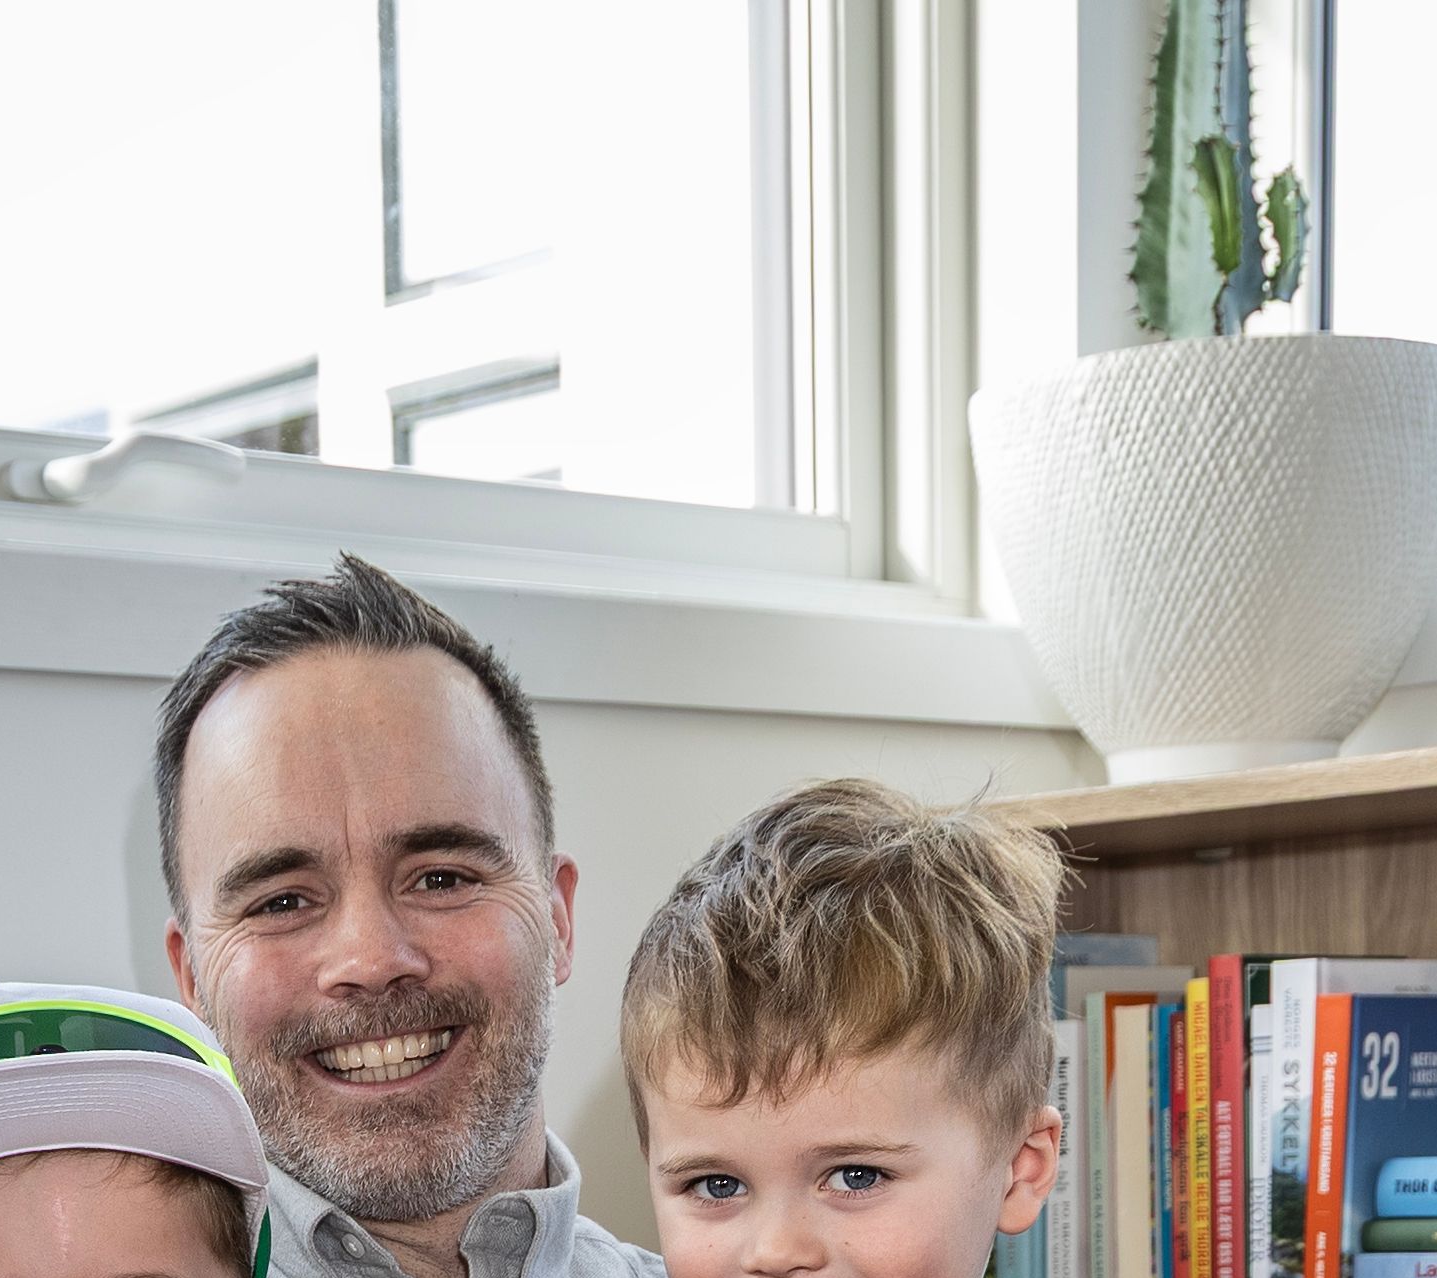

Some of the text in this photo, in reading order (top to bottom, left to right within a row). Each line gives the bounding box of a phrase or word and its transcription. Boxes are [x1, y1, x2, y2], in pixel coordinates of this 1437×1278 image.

[1193, 1001, 1208, 1050] MICAEL
[1193, 1051, 1209, 1102] DAHLEN
[1322, 1051, 1338, 1067] 32
[1361, 1031, 1401, 1100] 32
[1216, 1100, 1232, 1121] ALT
[1216, 1123, 1232, 1178] FOTBALL
[1196, 1182, 1211, 1221] HELGE
[1216, 1178, 1233, 1205] HAR
[1395, 1179, 1429, 1194] THOR
[1216, 1205, 1233, 1240] LÆRT
[1250, 1176, 1266, 1263] IDIOTER
[1217, 1241, 1233, 1265] OSS
